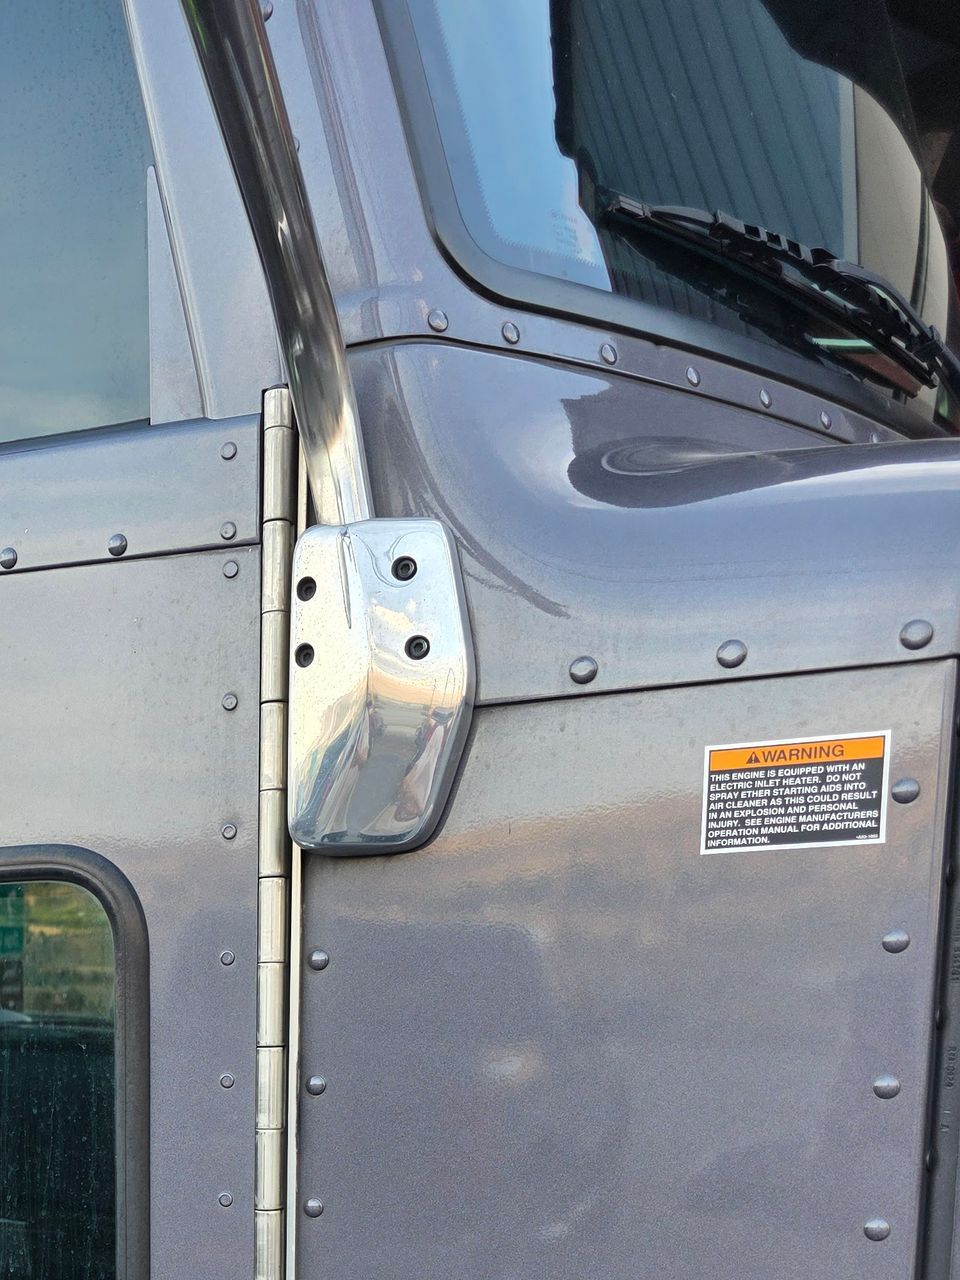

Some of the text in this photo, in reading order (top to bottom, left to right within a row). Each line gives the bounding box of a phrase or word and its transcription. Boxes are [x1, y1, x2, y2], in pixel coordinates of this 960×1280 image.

[762, 744, 845, 763] WARNING
[732, 770, 765, 780] ENGINE
[778, 766, 824, 777] EQUIPPED
[826, 764, 850, 772] WITH
[710, 773, 862, 791] ELECTRIC INLET HEATER. DO NOT
[710, 782, 866, 800] SPRAY ETHER STARTING AIDS INTO
[709, 802, 724, 810] AIR
[726, 799, 768, 809] CLEANER
[784, 796, 805, 804] THIS
[807, 793, 839, 803] COULD
[841, 791, 877, 800] RESULT
[734, 807, 784, 817] EXPLOSION
[787, 805, 806, 814] AND
[809, 802, 858, 812] PERSONAL
[709, 810, 878, 829] INJURY. SEE ENGINE MANUFACTURERS
[708, 820, 878, 838] OPERATION MANUAL FOR ADDITIONAL
[707, 837, 770, 847] INFORMATION.
